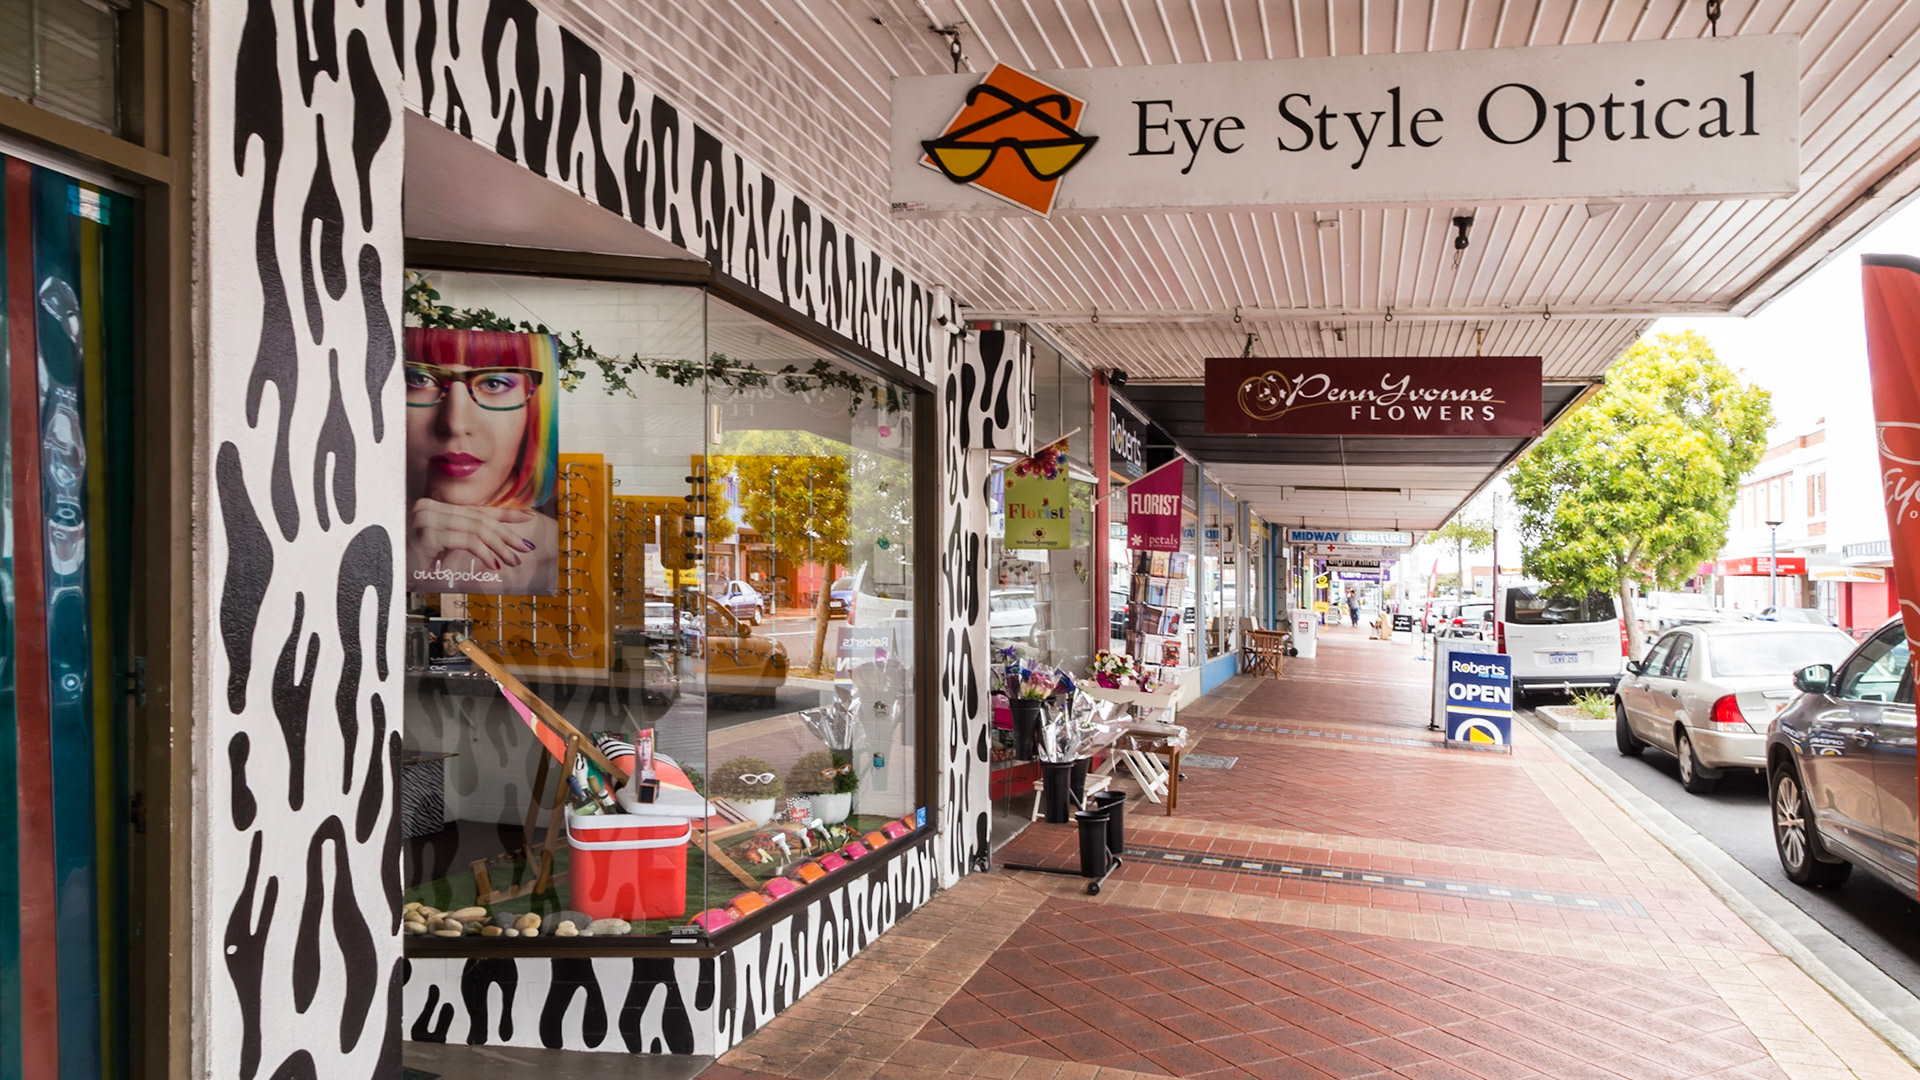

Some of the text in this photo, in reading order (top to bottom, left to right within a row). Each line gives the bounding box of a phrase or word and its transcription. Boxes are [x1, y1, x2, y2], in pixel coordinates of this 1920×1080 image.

[1128, 70, 1760, 173] Eye Style Optical
[1351, 405, 1496, 421] FLOWERS
[1111, 411, 1141, 466] Roberts
[1131, 493, 1180, 516] FLORIST
[1883, 467, 1920, 525] Ey
[1008, 501, 1066, 520] Florist
[1148, 533, 1178, 546] petals
[1292, 531, 1340, 542] MIDWAY
[413, 558, 503, 588] outspoken
[1452, 660, 1506, 676] Roberts
[1449, 682, 1511, 704] OPEN
